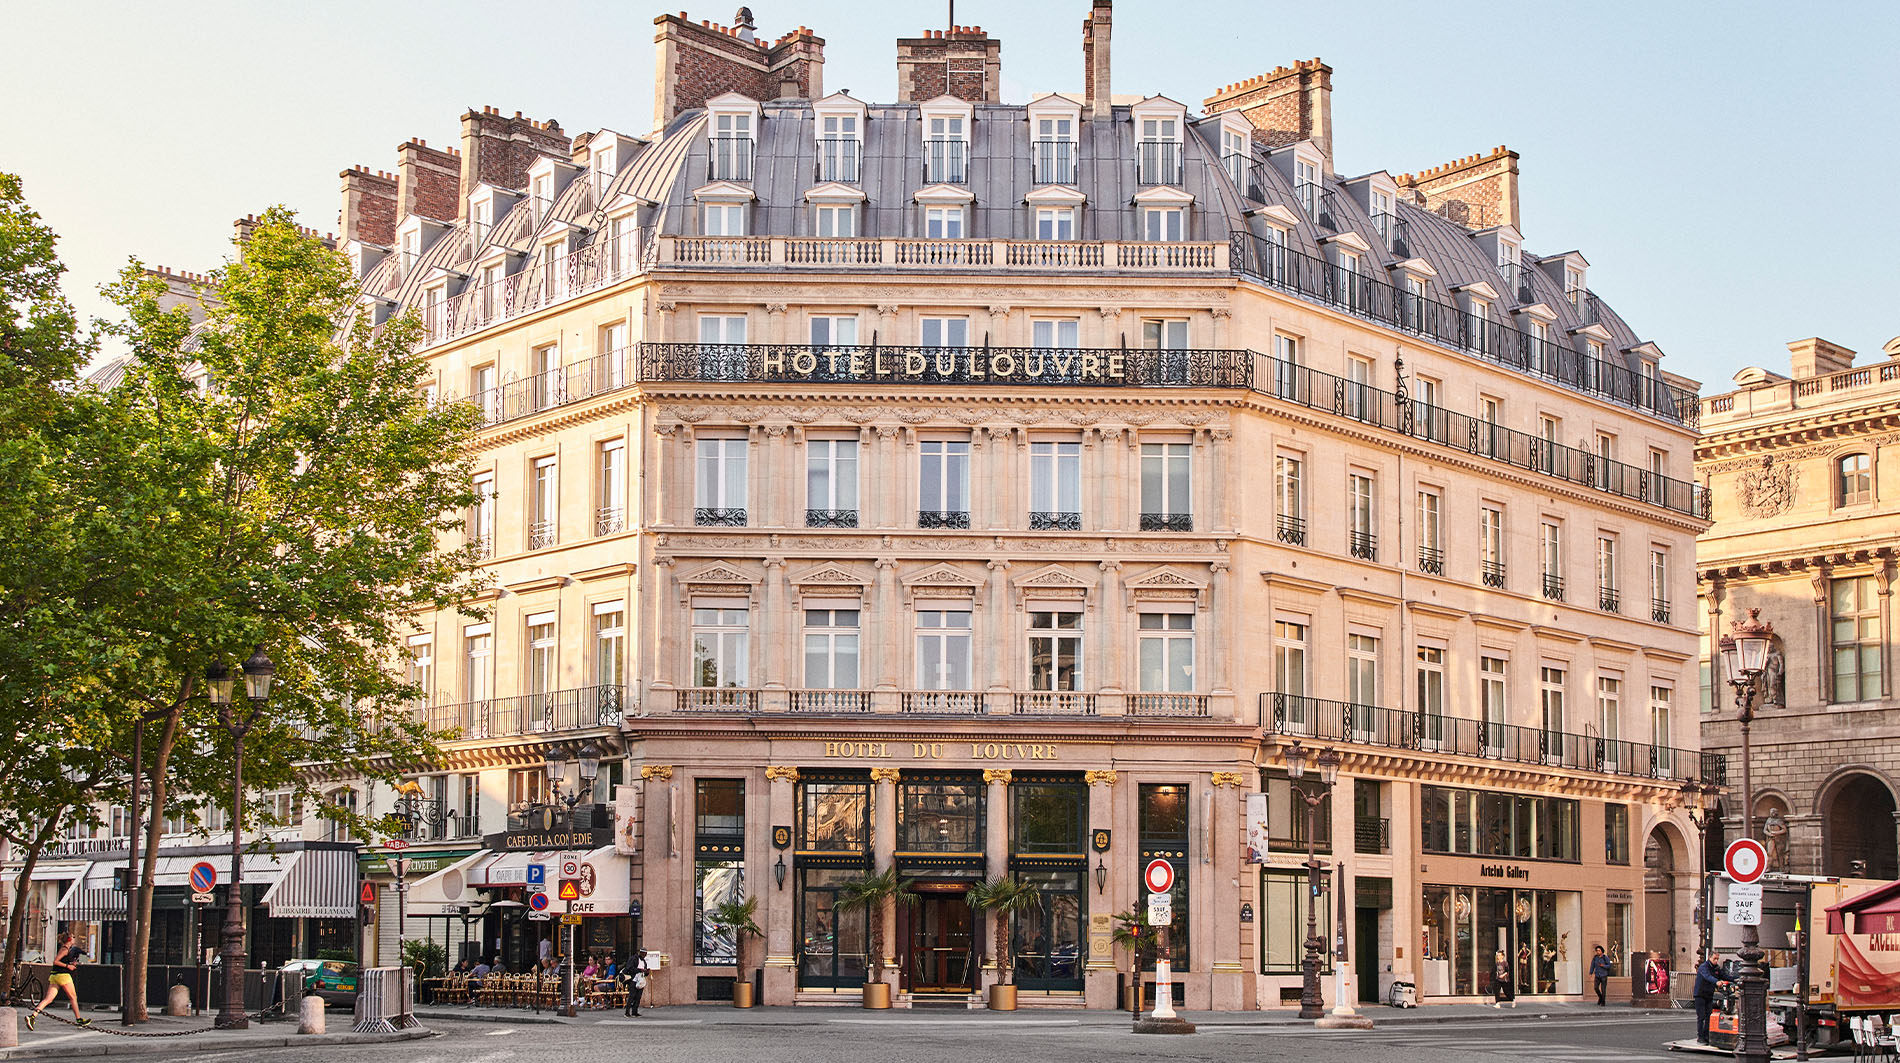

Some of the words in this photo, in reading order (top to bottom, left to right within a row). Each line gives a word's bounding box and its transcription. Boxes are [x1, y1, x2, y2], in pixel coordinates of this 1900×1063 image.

[763, 350, 891, 375] HOTEL
[905, 352, 956, 376] DU
[969, 352, 1125, 378] LOUVRE
[824, 742, 892, 758] HOTEL
[912, 743, 945, 759] DU
[971, 743, 1058, 760] LOUVRE
[506, 835, 526, 848] CAFE
[527, 834, 539, 847] DE
[540, 834, 553, 847] LA
[411, 860, 438, 870] CIVETTE
[531, 868, 540, 881] P
[1480, 864, 1504, 878] Artclub
[1506, 865, 1529, 881] Gallery
[572, 903, 594, 912] CAFE
